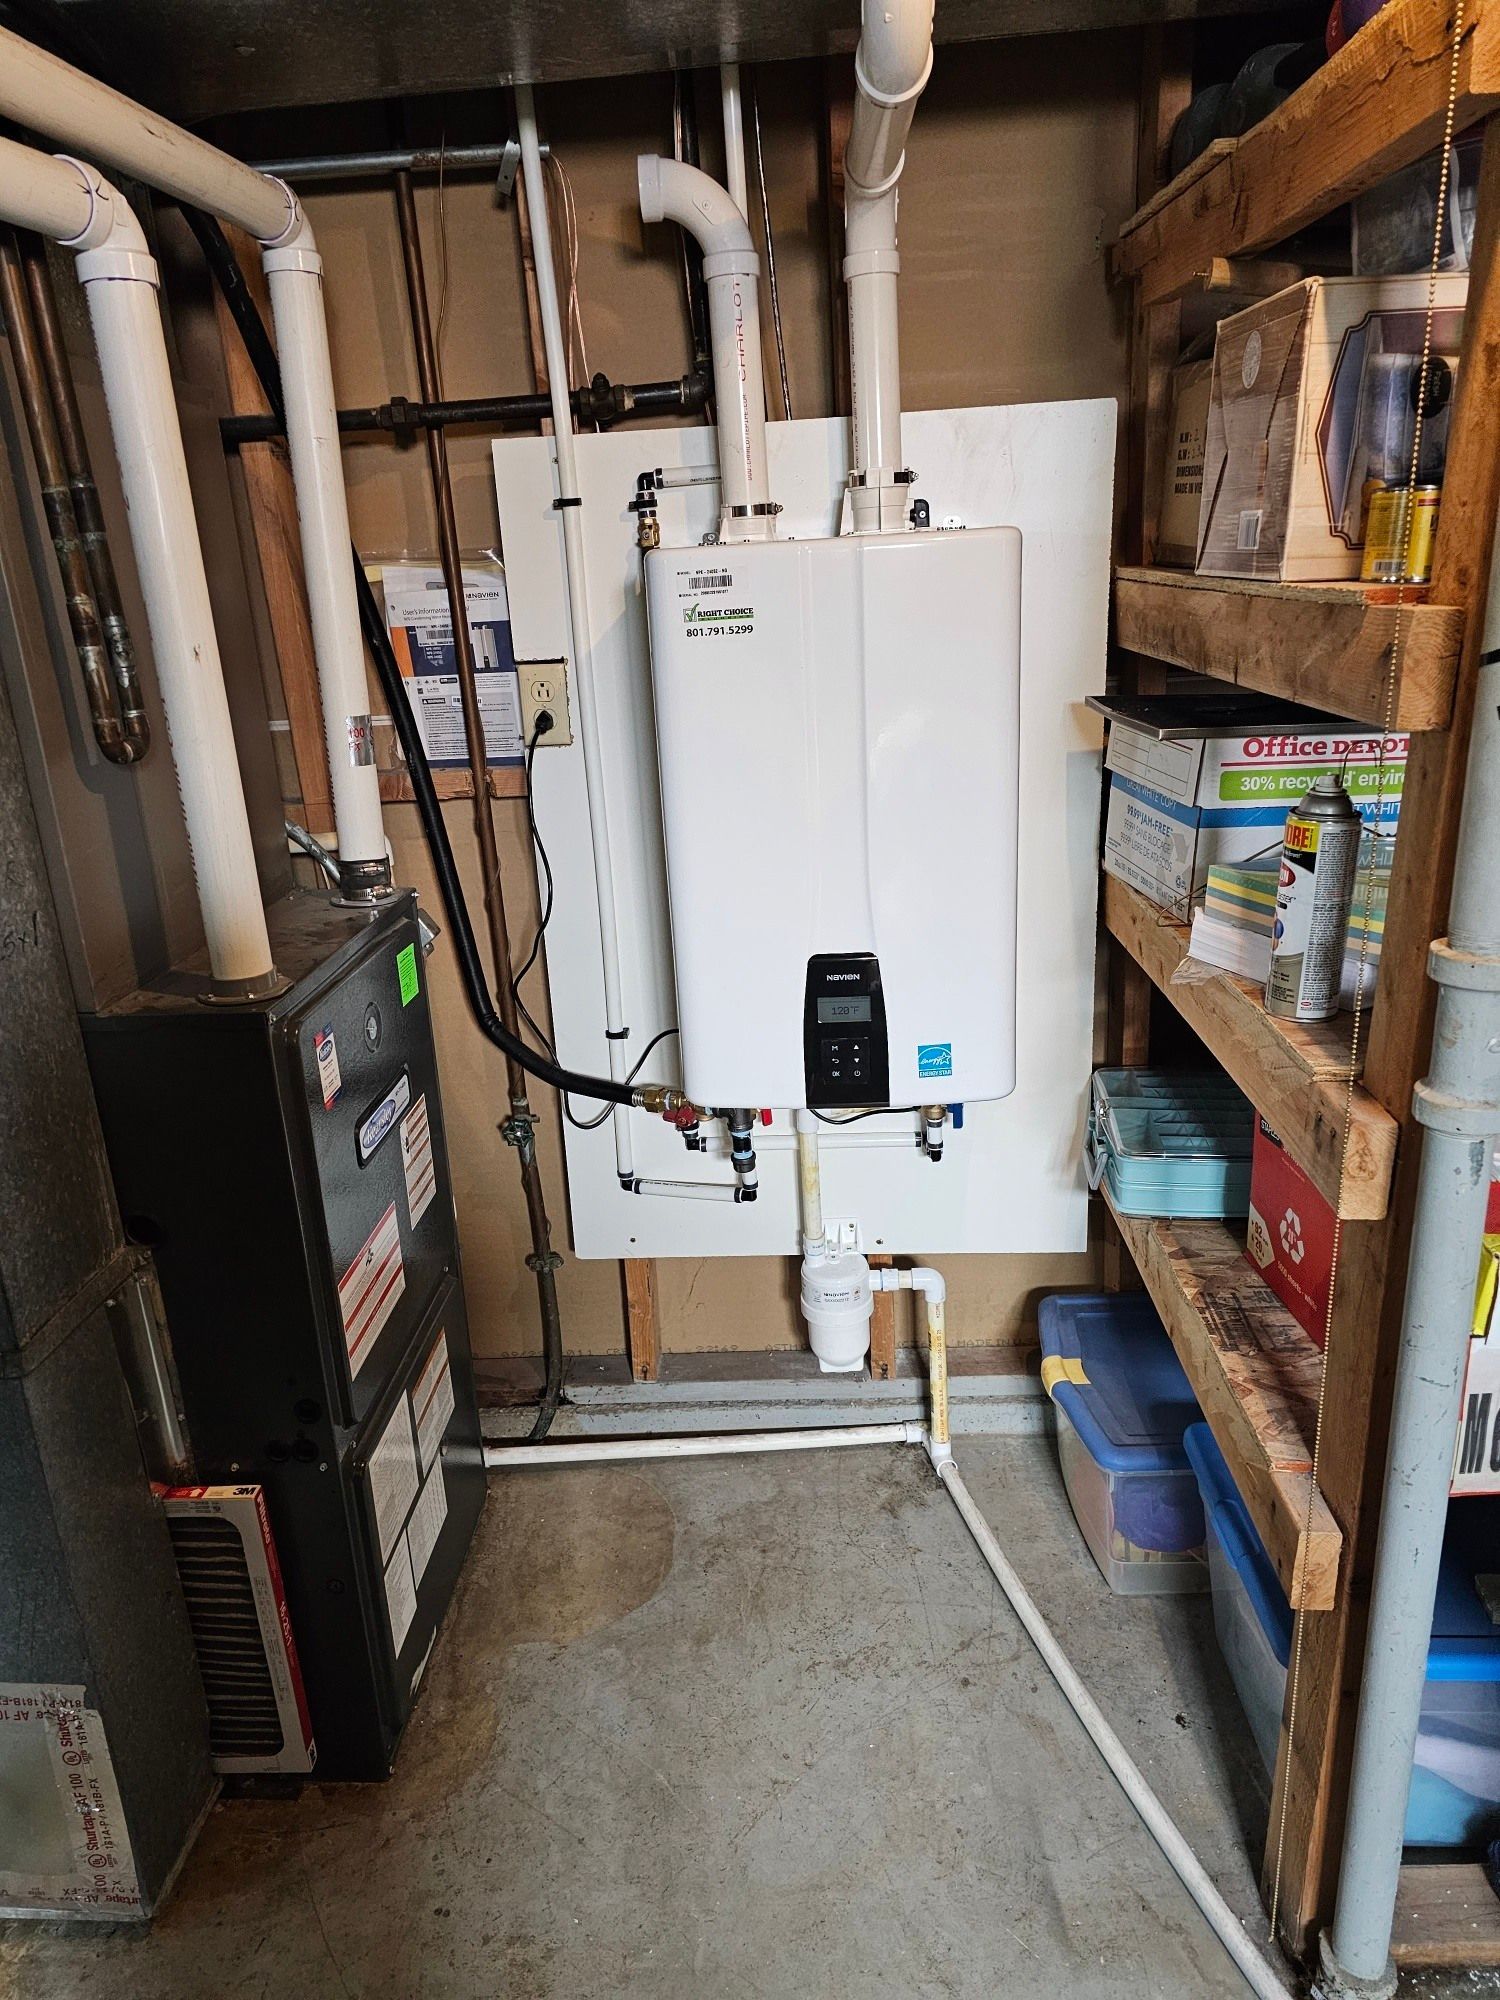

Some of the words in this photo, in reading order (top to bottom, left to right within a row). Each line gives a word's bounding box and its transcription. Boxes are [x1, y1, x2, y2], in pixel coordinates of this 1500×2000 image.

[1174, 482, 1188, 494] MADE
[697, 609, 722, 617] RIGHT
[724, 607, 753, 615] CHOICE
[686, 625, 754, 637] 801.791.5299
[1243, 735, 1328, 758] Office
[1241, 776, 1275, 791] 30%
[232, 1487, 257, 1496] 3M
[14, 1710, 29, 1721] AF
[68, 1773, 85, 1791] 100
